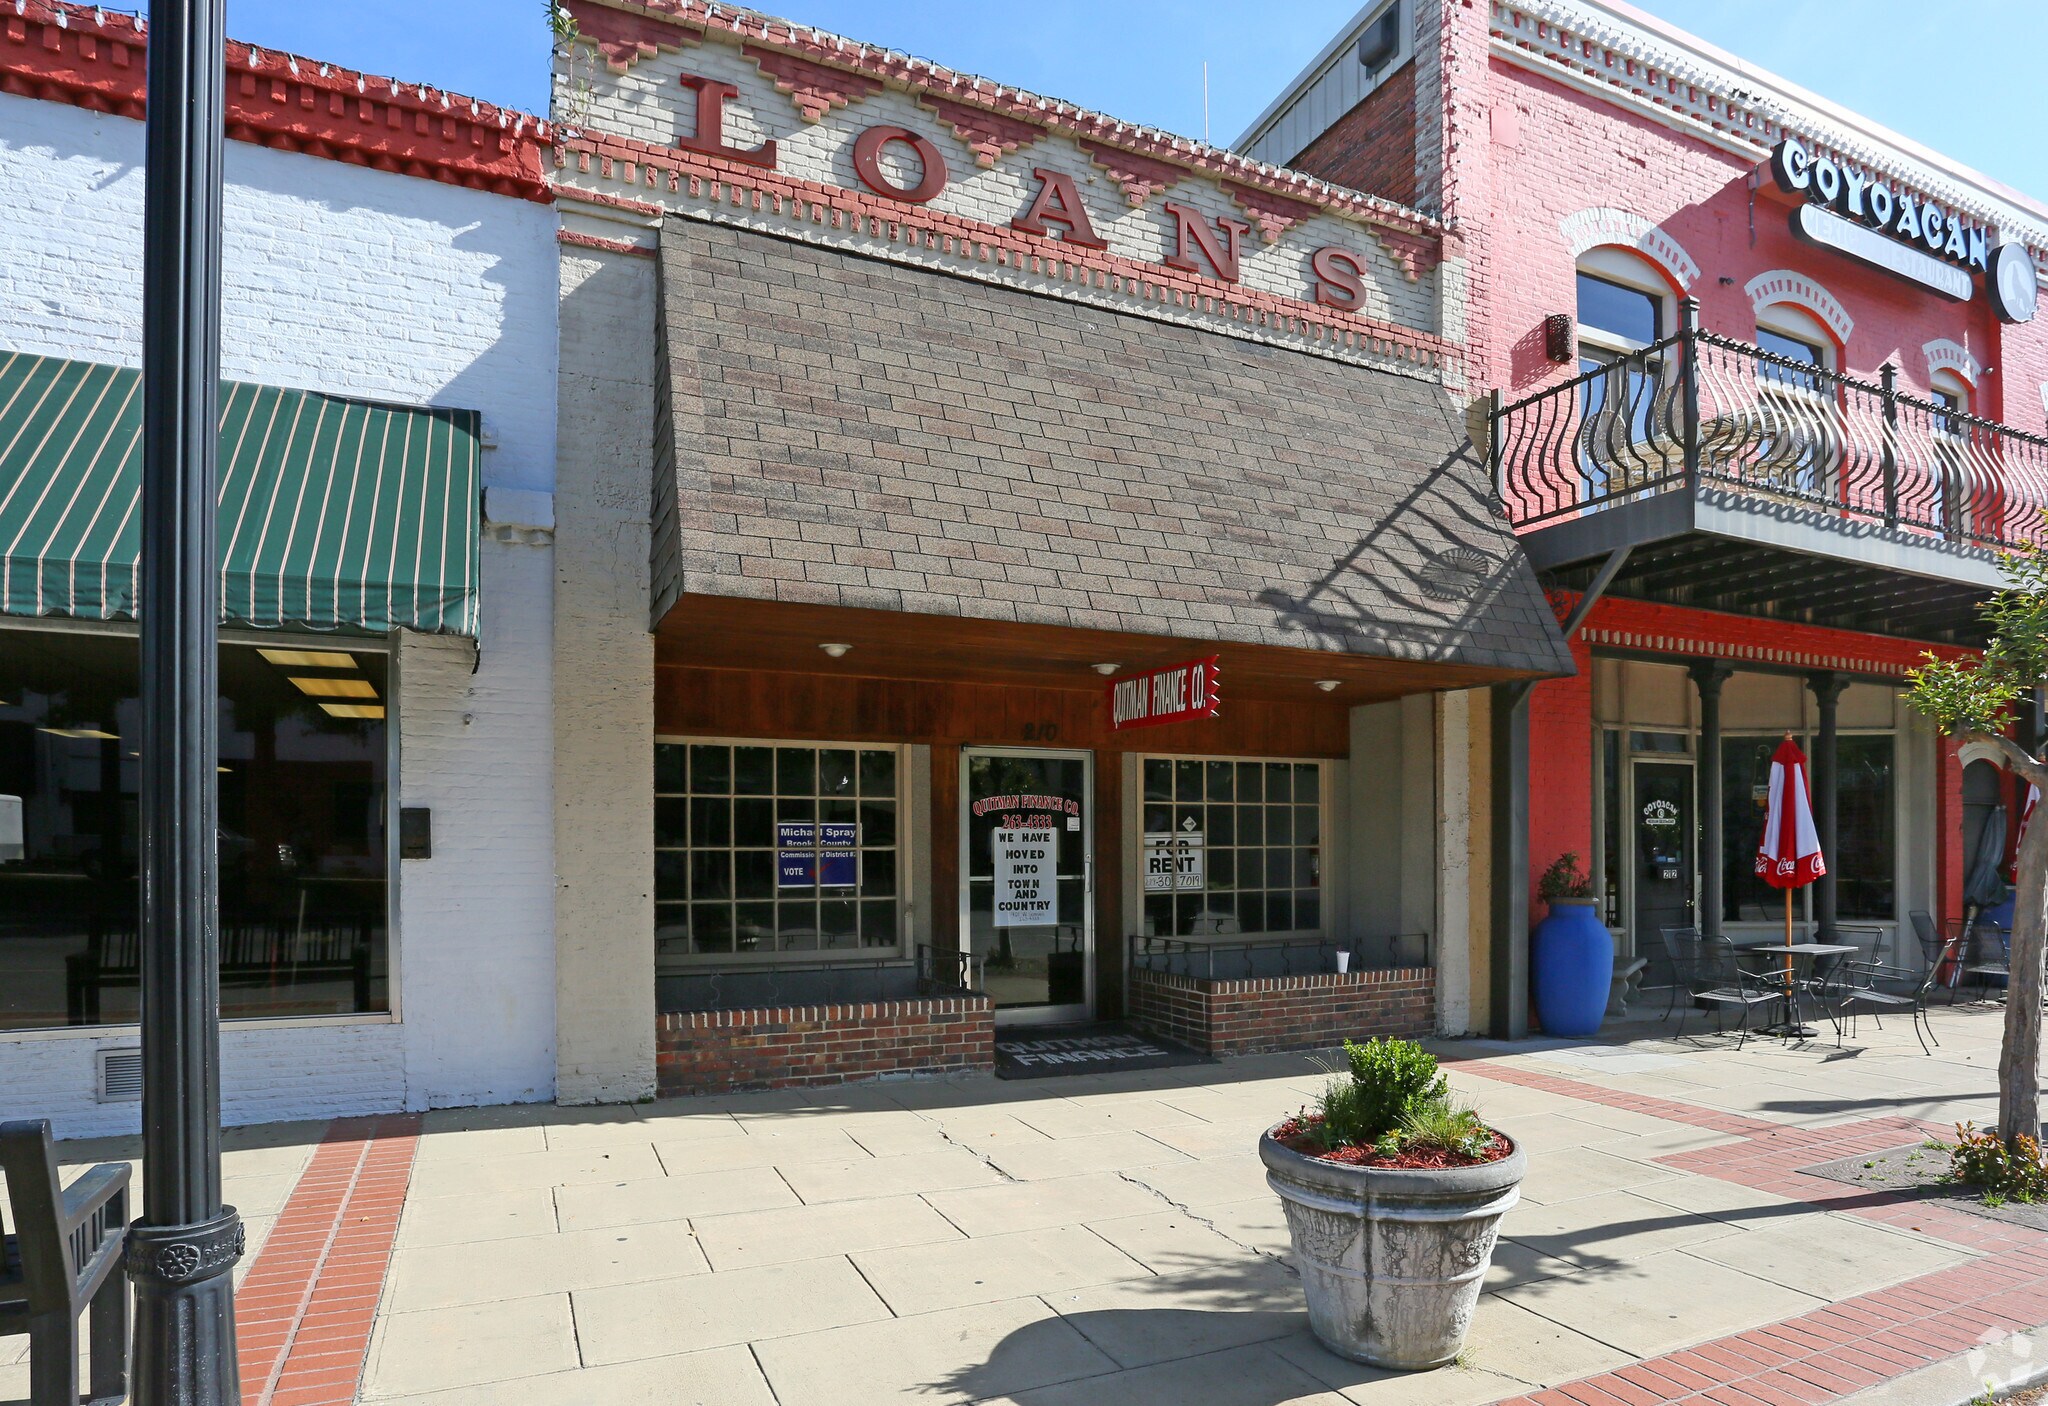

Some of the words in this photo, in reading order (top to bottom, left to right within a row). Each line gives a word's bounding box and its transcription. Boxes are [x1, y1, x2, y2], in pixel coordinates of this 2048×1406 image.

[680, 73, 1367, 311] LOANS
[1780, 138, 1987, 272] COYOACAN
[1113, 677, 1148, 729] QUITMAN
[1152, 669, 1187, 716] FINANCE
[1191, 664, 1206, 709] CO.
[973, 795, 1020, 816] QUITMAN
[1021, 795, 1063, 811] FINANCE
[1643, 799, 1679, 816] COYOACAN
[1002, 814, 1052, 829] 263-4333
[780, 828, 823, 837] Michal
[826, 828, 856, 838] Spray
[999, 833, 1014, 842] WE
[1022, 833, 1050, 842] HAVE
[1006, 850, 1045, 859] MOVED
[1155, 841, 1190, 856] FOR
[784, 867, 804, 876] VOTE
[1013, 864, 1038, 874] INTO
[1149, 857, 1196, 873] RENT
[1008, 879, 1040, 889] TOWN
[1015, 890, 1037, 899] AND
[998, 901, 1050, 911] COUNTRY
[996, 1034, 1143, 1054] QUITMAN
[1012, 1045, 1169, 1066] FINANCE
